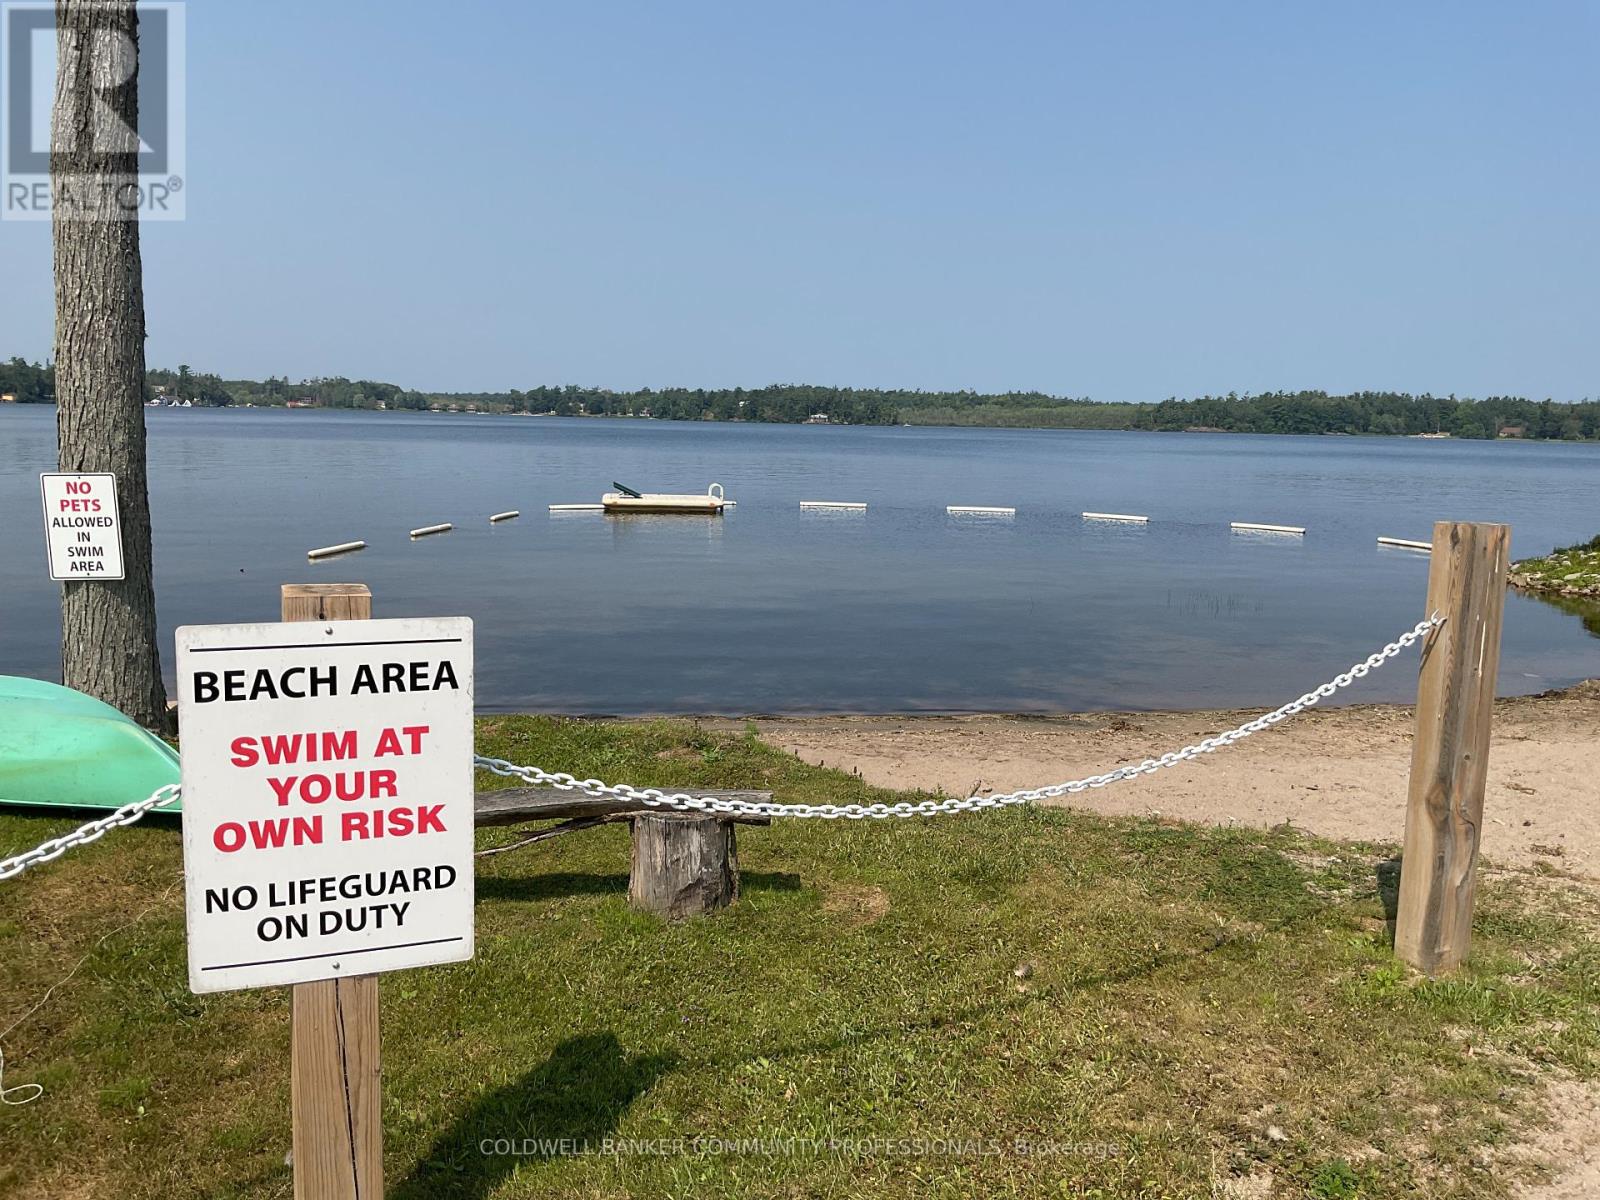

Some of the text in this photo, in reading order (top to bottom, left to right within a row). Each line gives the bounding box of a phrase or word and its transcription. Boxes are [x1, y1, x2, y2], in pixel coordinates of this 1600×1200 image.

[65, 481, 92, 494] NO
[60, 499, 101, 512] PETS
[52, 516, 113, 528] ALLOWED
[77, 531, 91, 542] IN
[67, 546, 104, 557] SWIM
[70, 561, 104, 572] AREA
[193, 660, 459, 703] BEACH AREA
[230, 725, 430, 768] SWIM AT
[267, 769, 398, 807] YOUR
[213, 804, 448, 853] OWN RISK
[205, 864, 457, 914] NO LIFEGUARD
[256, 902, 411, 942] ON DUTY
